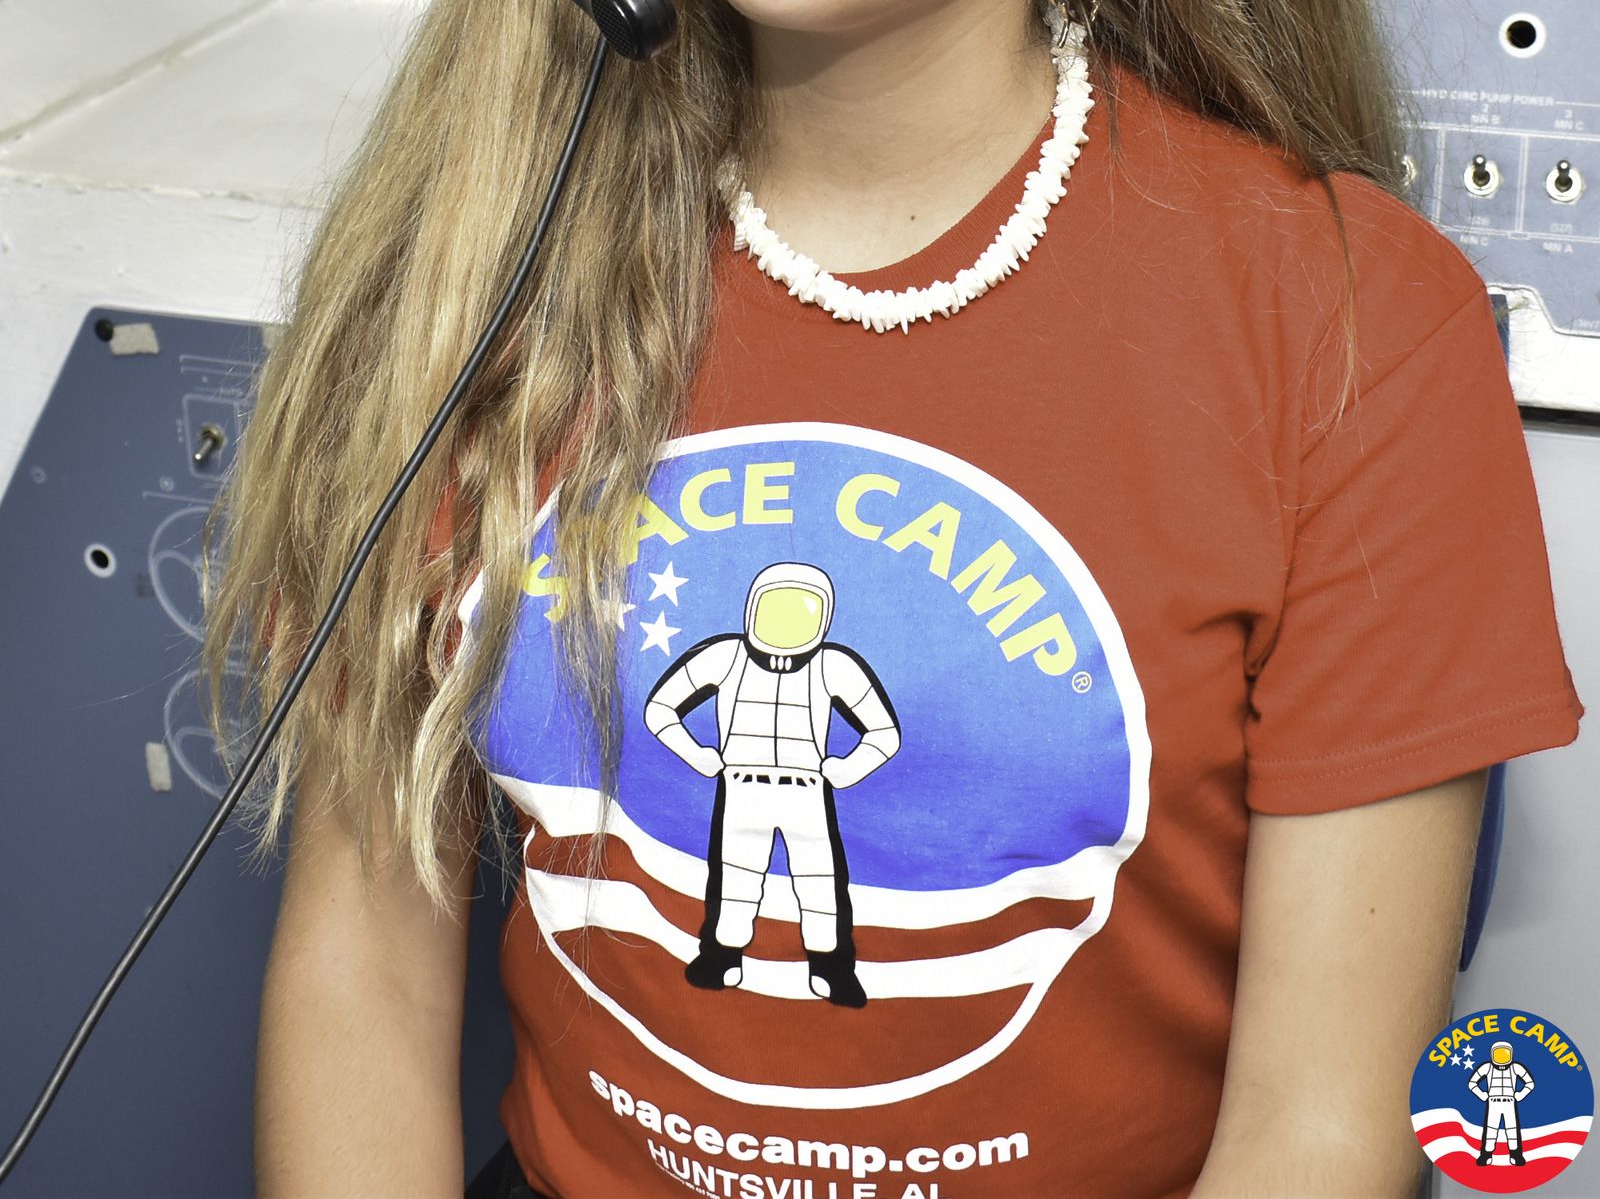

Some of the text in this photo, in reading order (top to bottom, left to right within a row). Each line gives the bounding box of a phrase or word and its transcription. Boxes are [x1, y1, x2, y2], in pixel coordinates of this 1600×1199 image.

[1423, 88, 1448, 99] HYD
[1543, 241, 1562, 253] MN
[523, 462, 795, 624] SACE
[835, 473, 1077, 675] CAMP
[588, 1070, 1029, 1178] spacecamp.com
[647, 1138, 877, 1199] HUNTSVILLE
